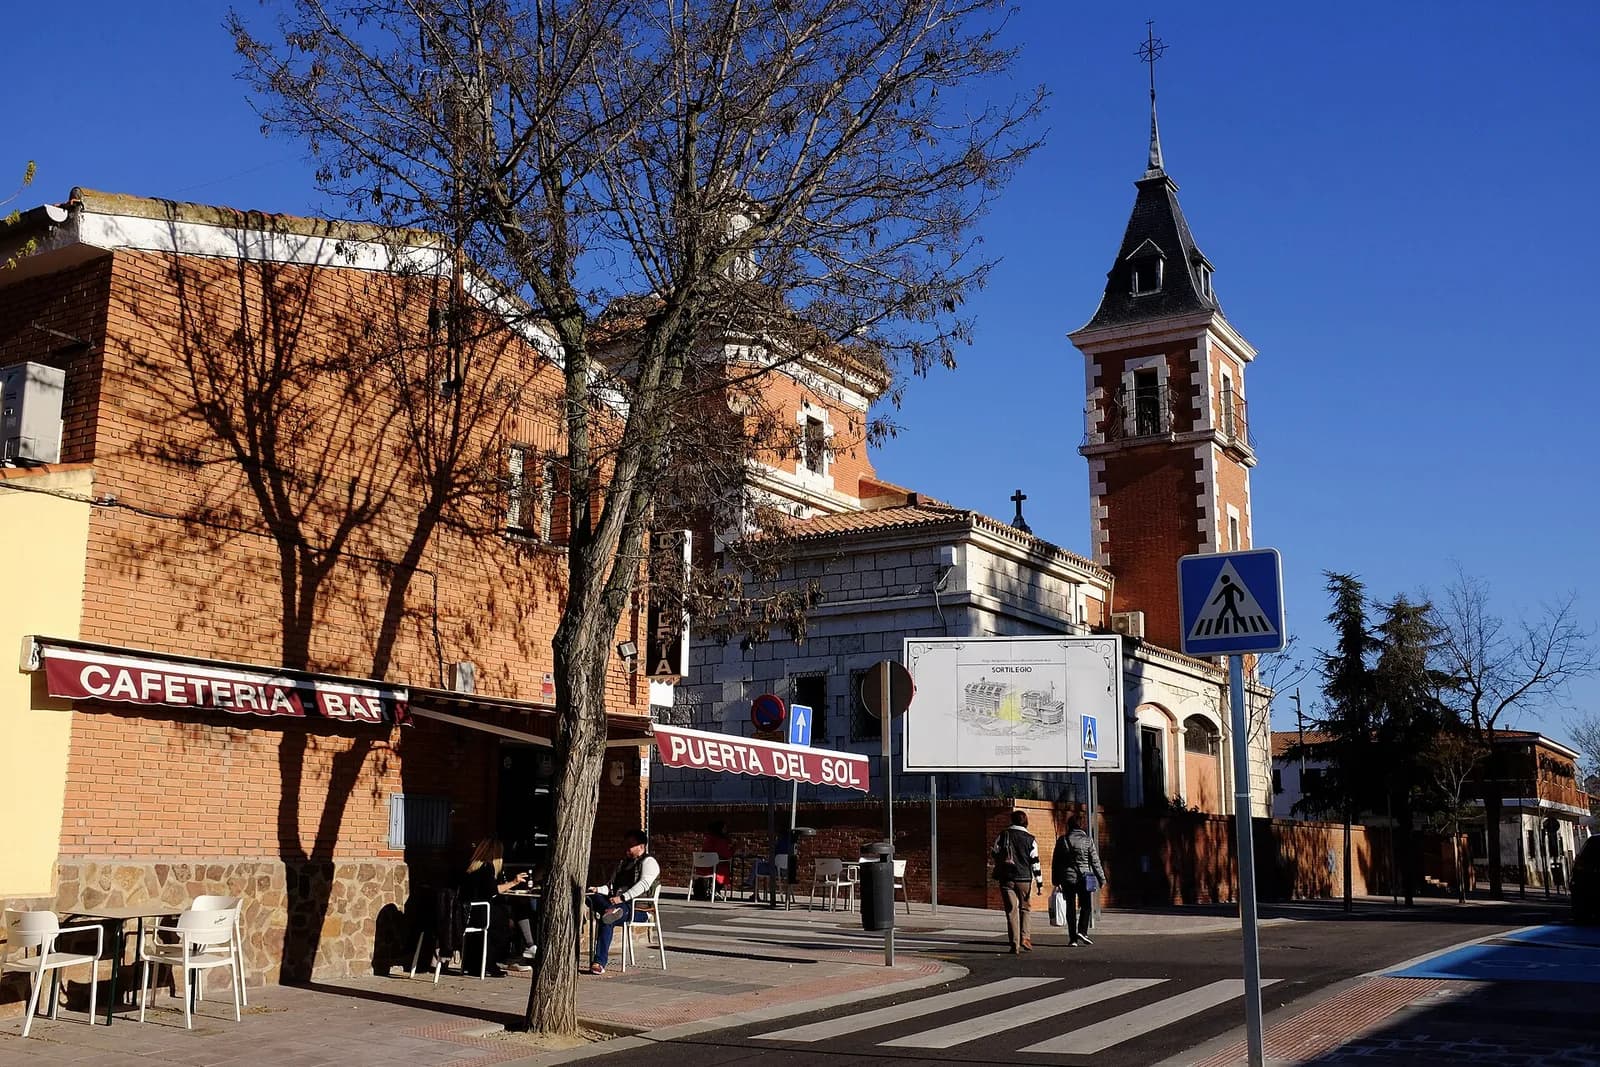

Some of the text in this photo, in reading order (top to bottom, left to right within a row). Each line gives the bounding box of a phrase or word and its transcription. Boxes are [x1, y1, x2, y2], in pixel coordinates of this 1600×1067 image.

[79, 665, 295, 713] CAFETERIA
[322, 693, 390, 721] BAR
[670, 735, 764, 772] PUERTA
[772, 751, 811, 779] DEL
[821, 758, 860, 785] SOL
